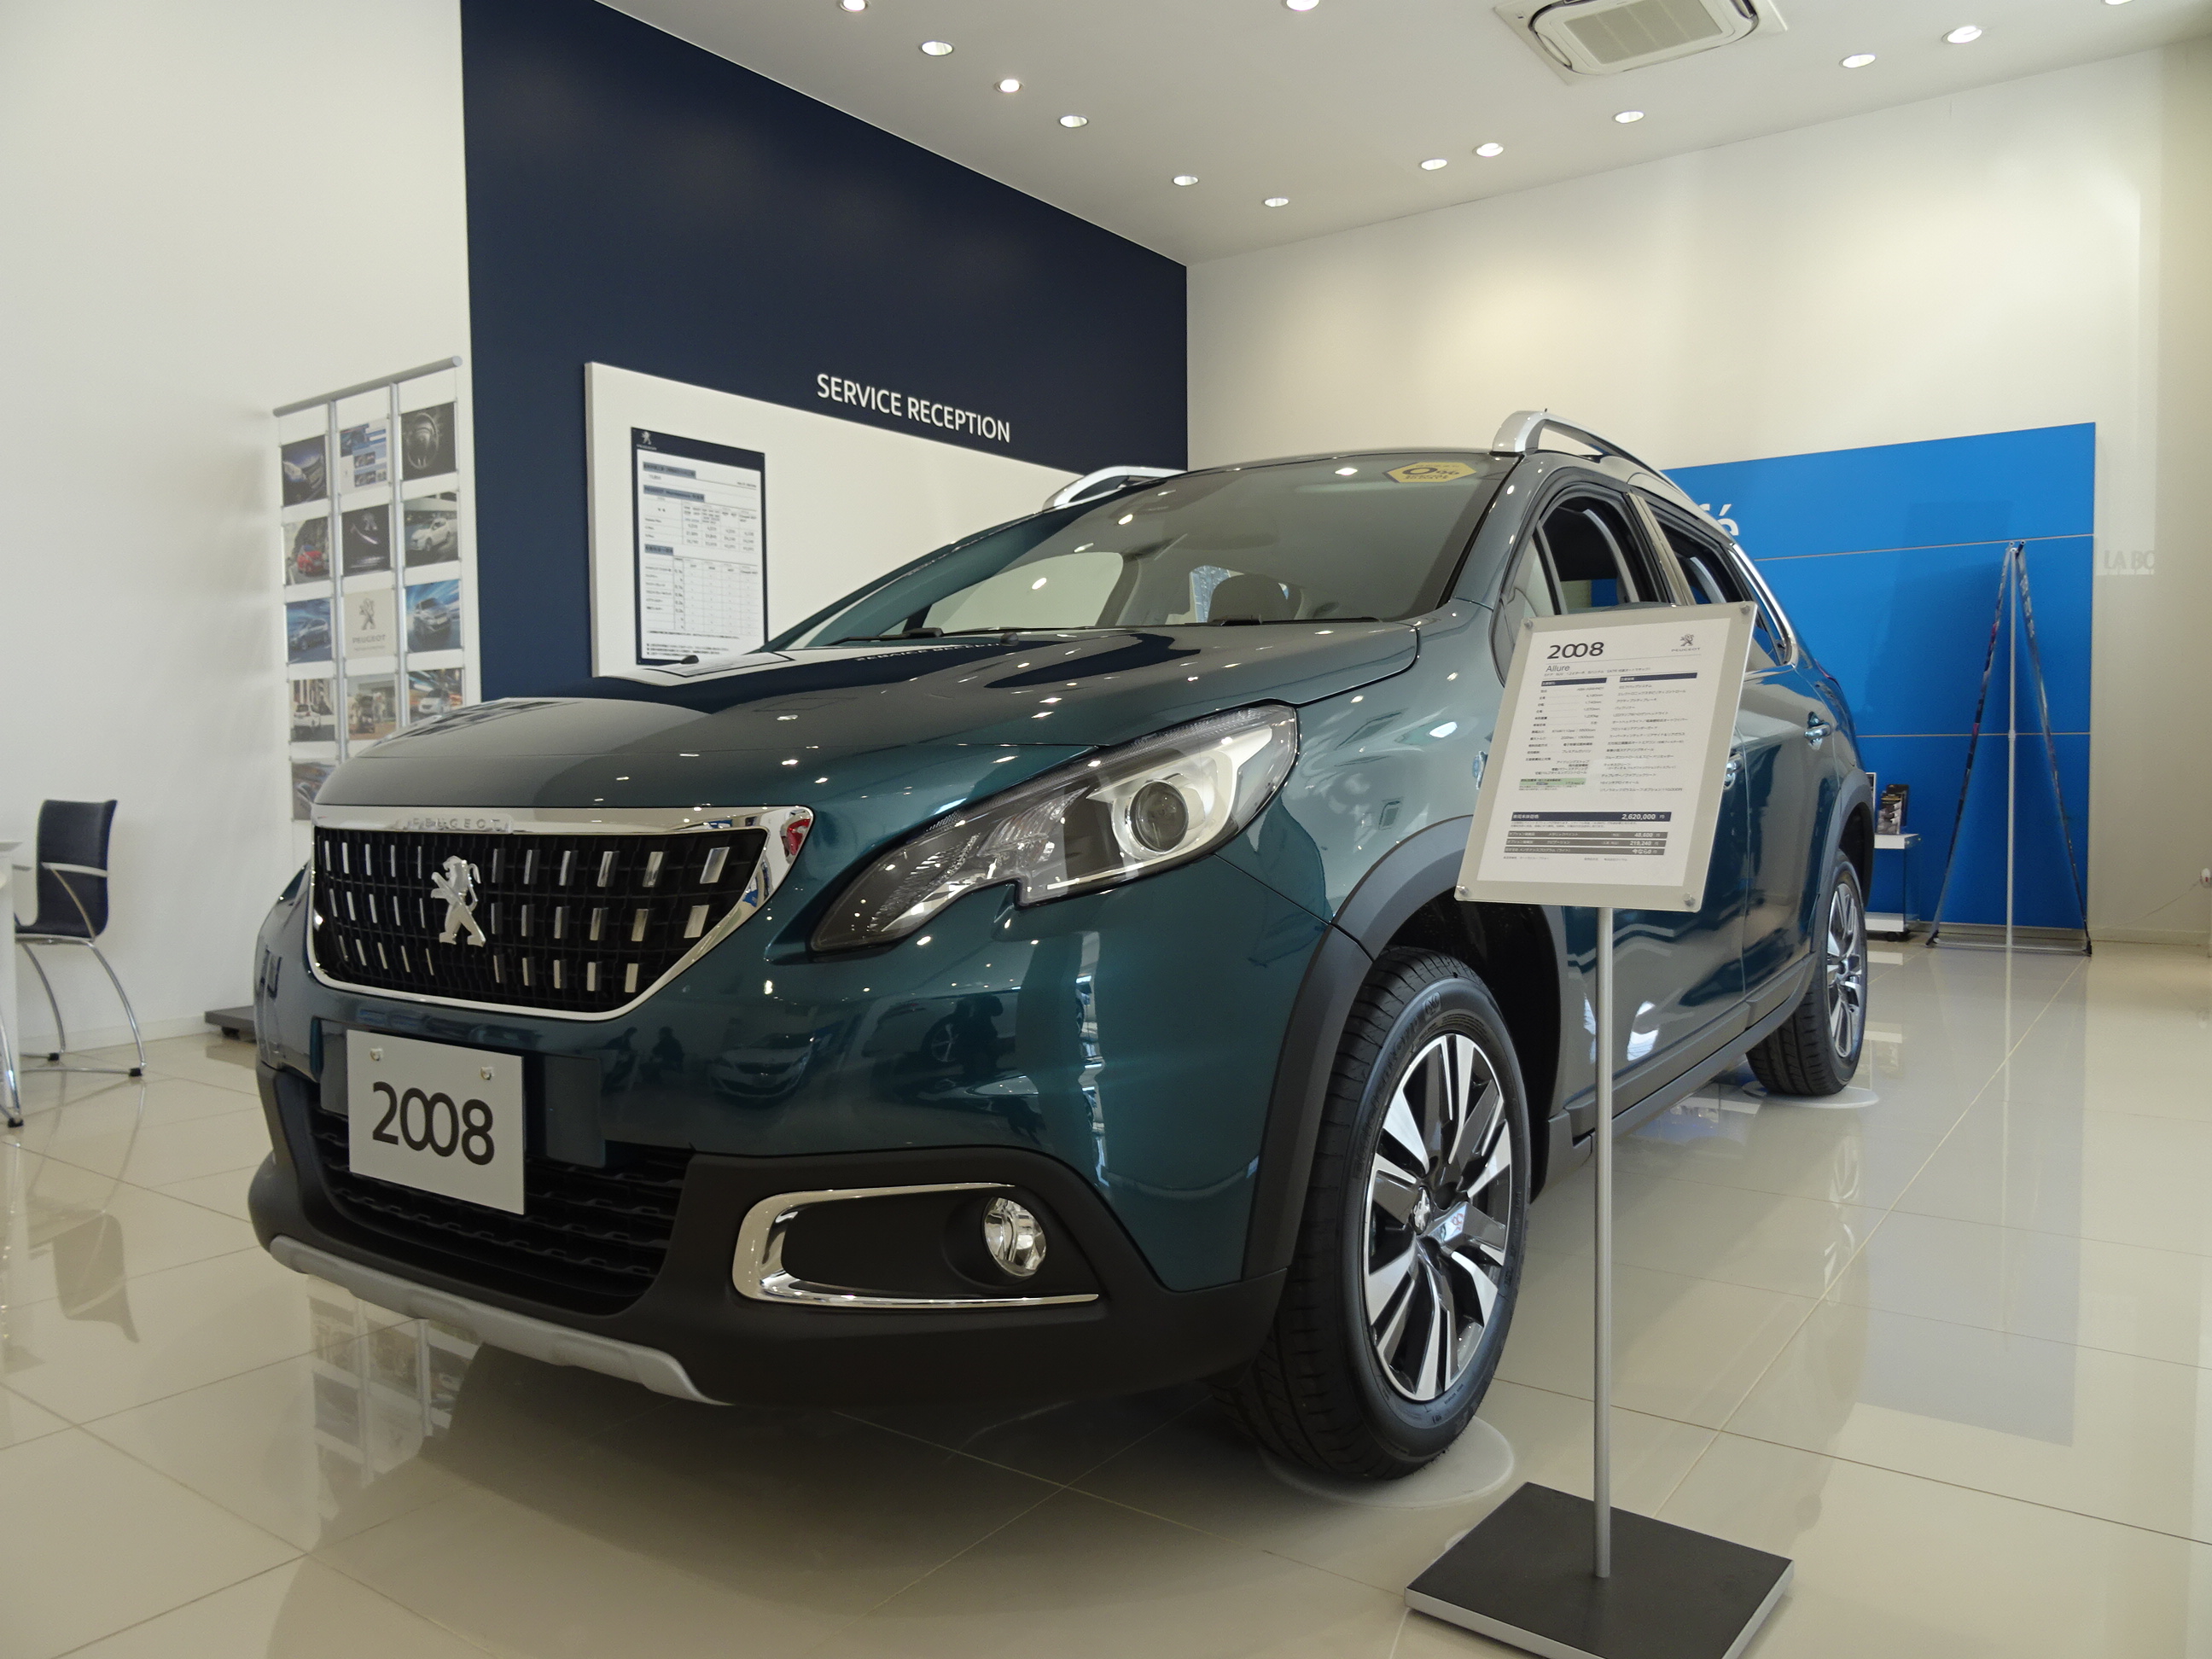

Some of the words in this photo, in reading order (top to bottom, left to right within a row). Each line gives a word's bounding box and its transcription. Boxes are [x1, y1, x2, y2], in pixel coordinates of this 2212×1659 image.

[817, 374, 902, 416] SERVICE
[907, 398, 1011, 443] RECEPTION
[1546, 642, 1604, 659] 2008
[372, 1082, 495, 1166] 2008
